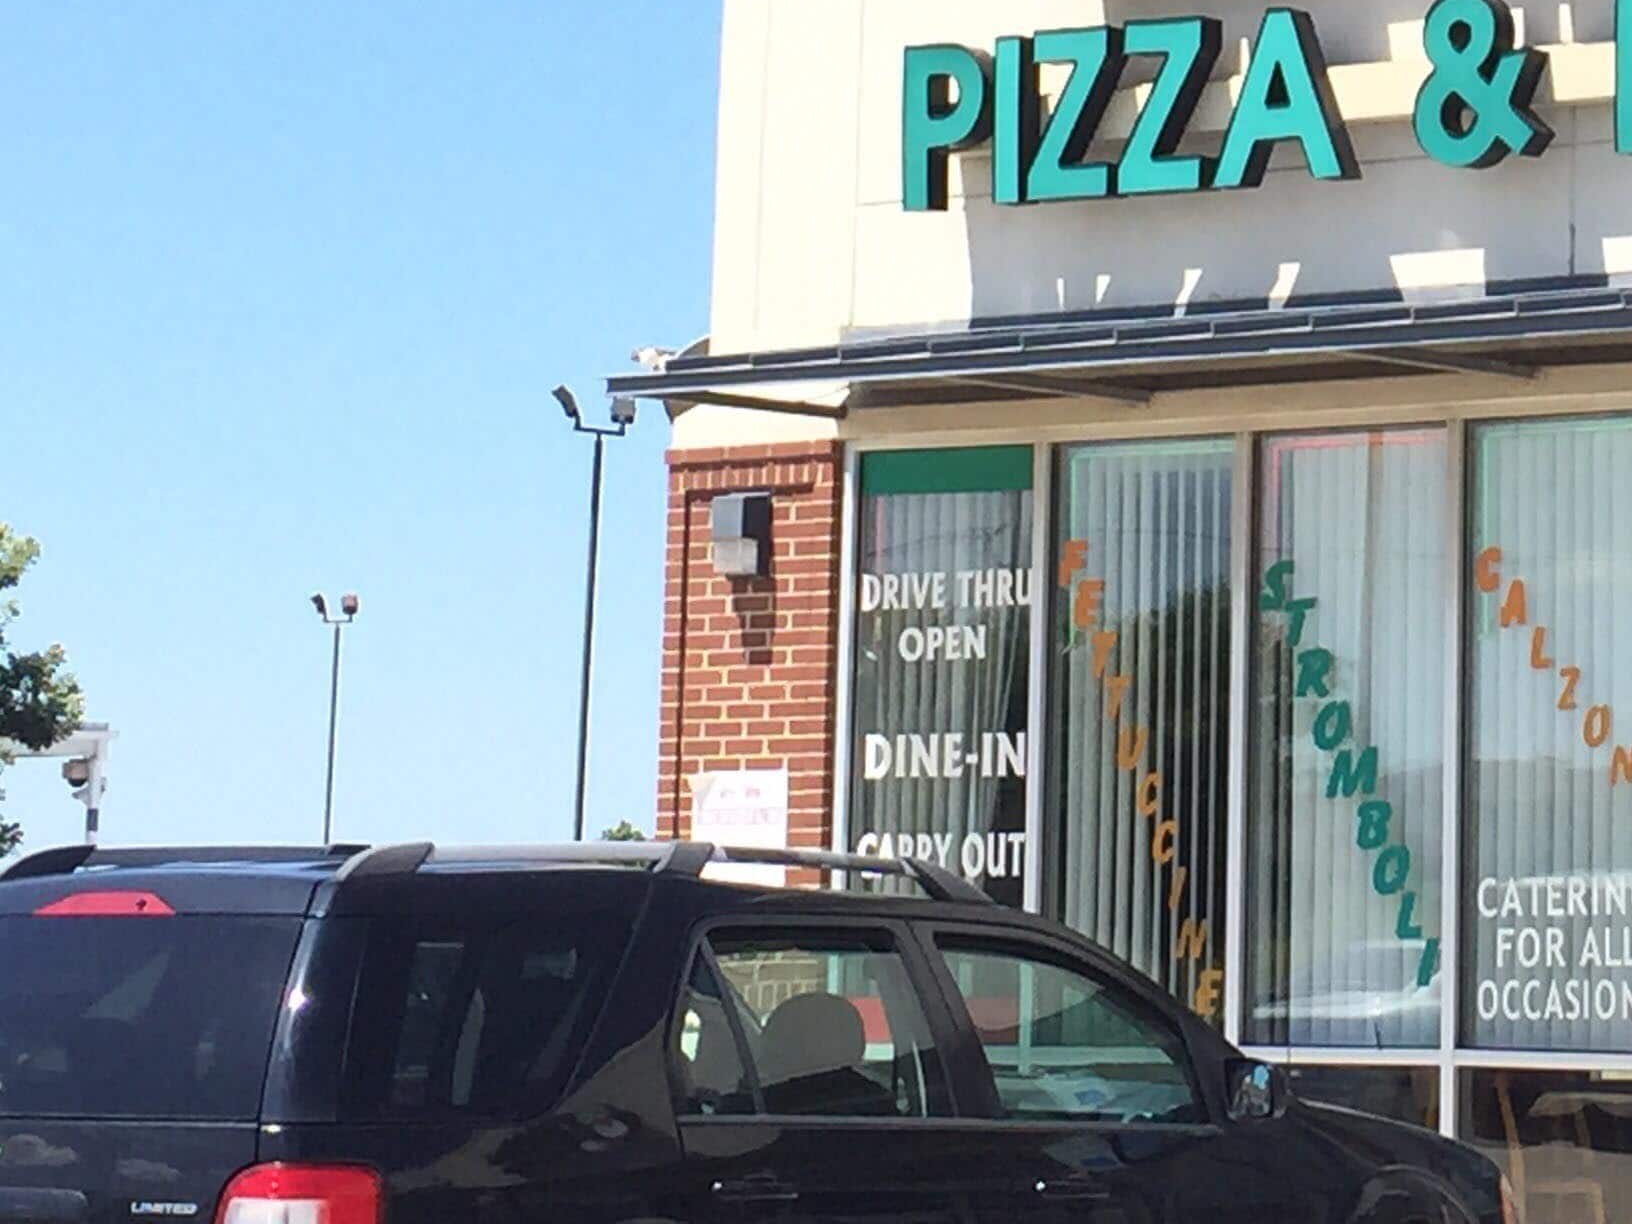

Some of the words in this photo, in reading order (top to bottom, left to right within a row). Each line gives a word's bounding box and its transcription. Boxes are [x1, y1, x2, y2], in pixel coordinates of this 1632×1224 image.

[901, 6, 1363, 212] PIZZA
[861, 570, 947, 612] DRIVE
[957, 567, 1033, 607] THRU
[899, 625, 987, 661] OPEN
[864, 732, 1027, 781] DINE-IN
[1060, 539, 1225, 1017] FETTUCCINE
[1260, 560, 1441, 987] STROMBOLI
[961, 832, 1026, 877] OUT
[1497, 927, 1566, 968] FOR
